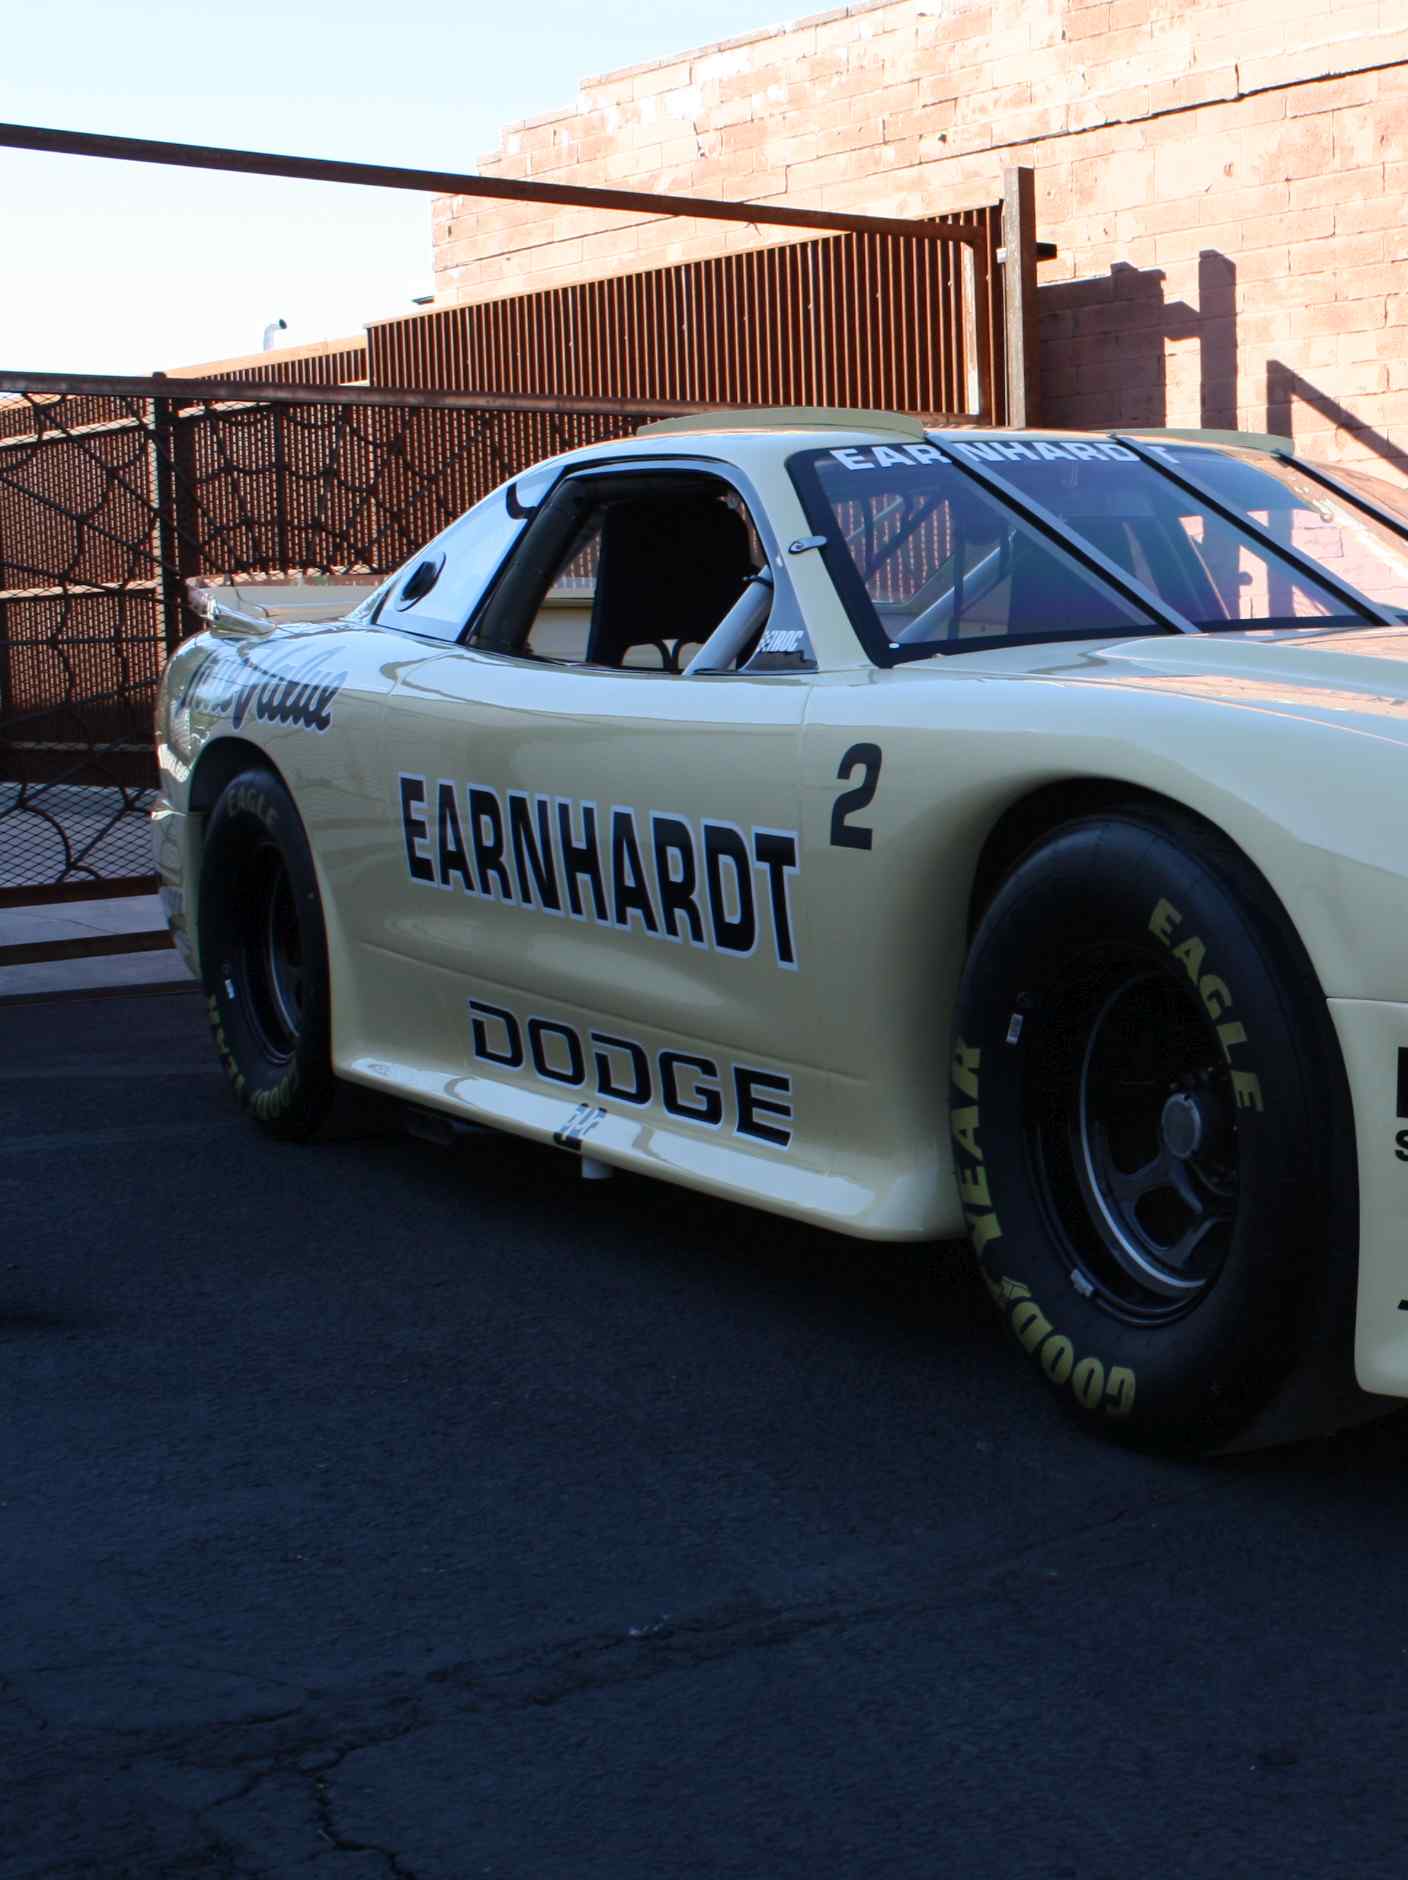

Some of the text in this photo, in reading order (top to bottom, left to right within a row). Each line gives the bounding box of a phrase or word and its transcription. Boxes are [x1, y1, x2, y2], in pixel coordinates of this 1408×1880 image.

[399, 772, 800, 971] EARNHARDT
[829, 742, 882, 850] 2
[467, 1000, 793, 1148] DODGE
[1148, 897, 1265, 1113] EAGLE
